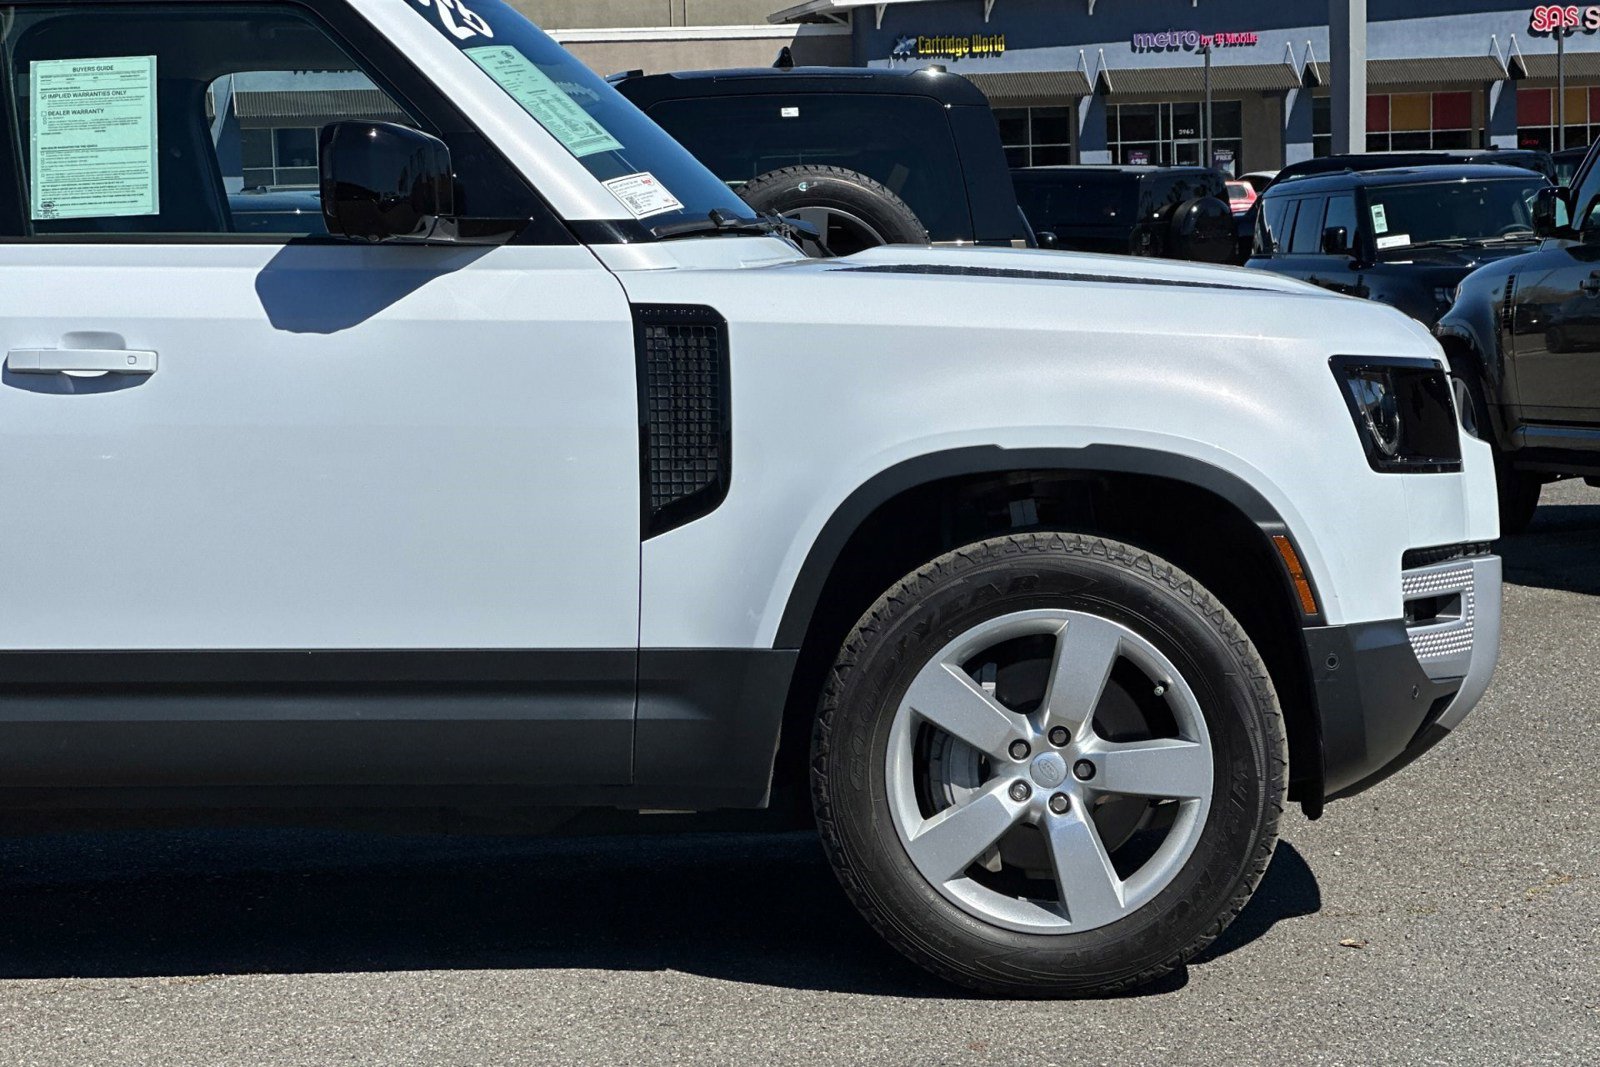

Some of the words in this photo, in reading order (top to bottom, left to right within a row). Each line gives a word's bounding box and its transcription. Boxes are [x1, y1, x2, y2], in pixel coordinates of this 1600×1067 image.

[1531, 5, 1580, 31] SAS
[918, 36, 969, 56] Cartridge
[972, 34, 1005, 52] World
[1133, 29, 1200, 47] metro
[1200, 34, 1213, 46] by
